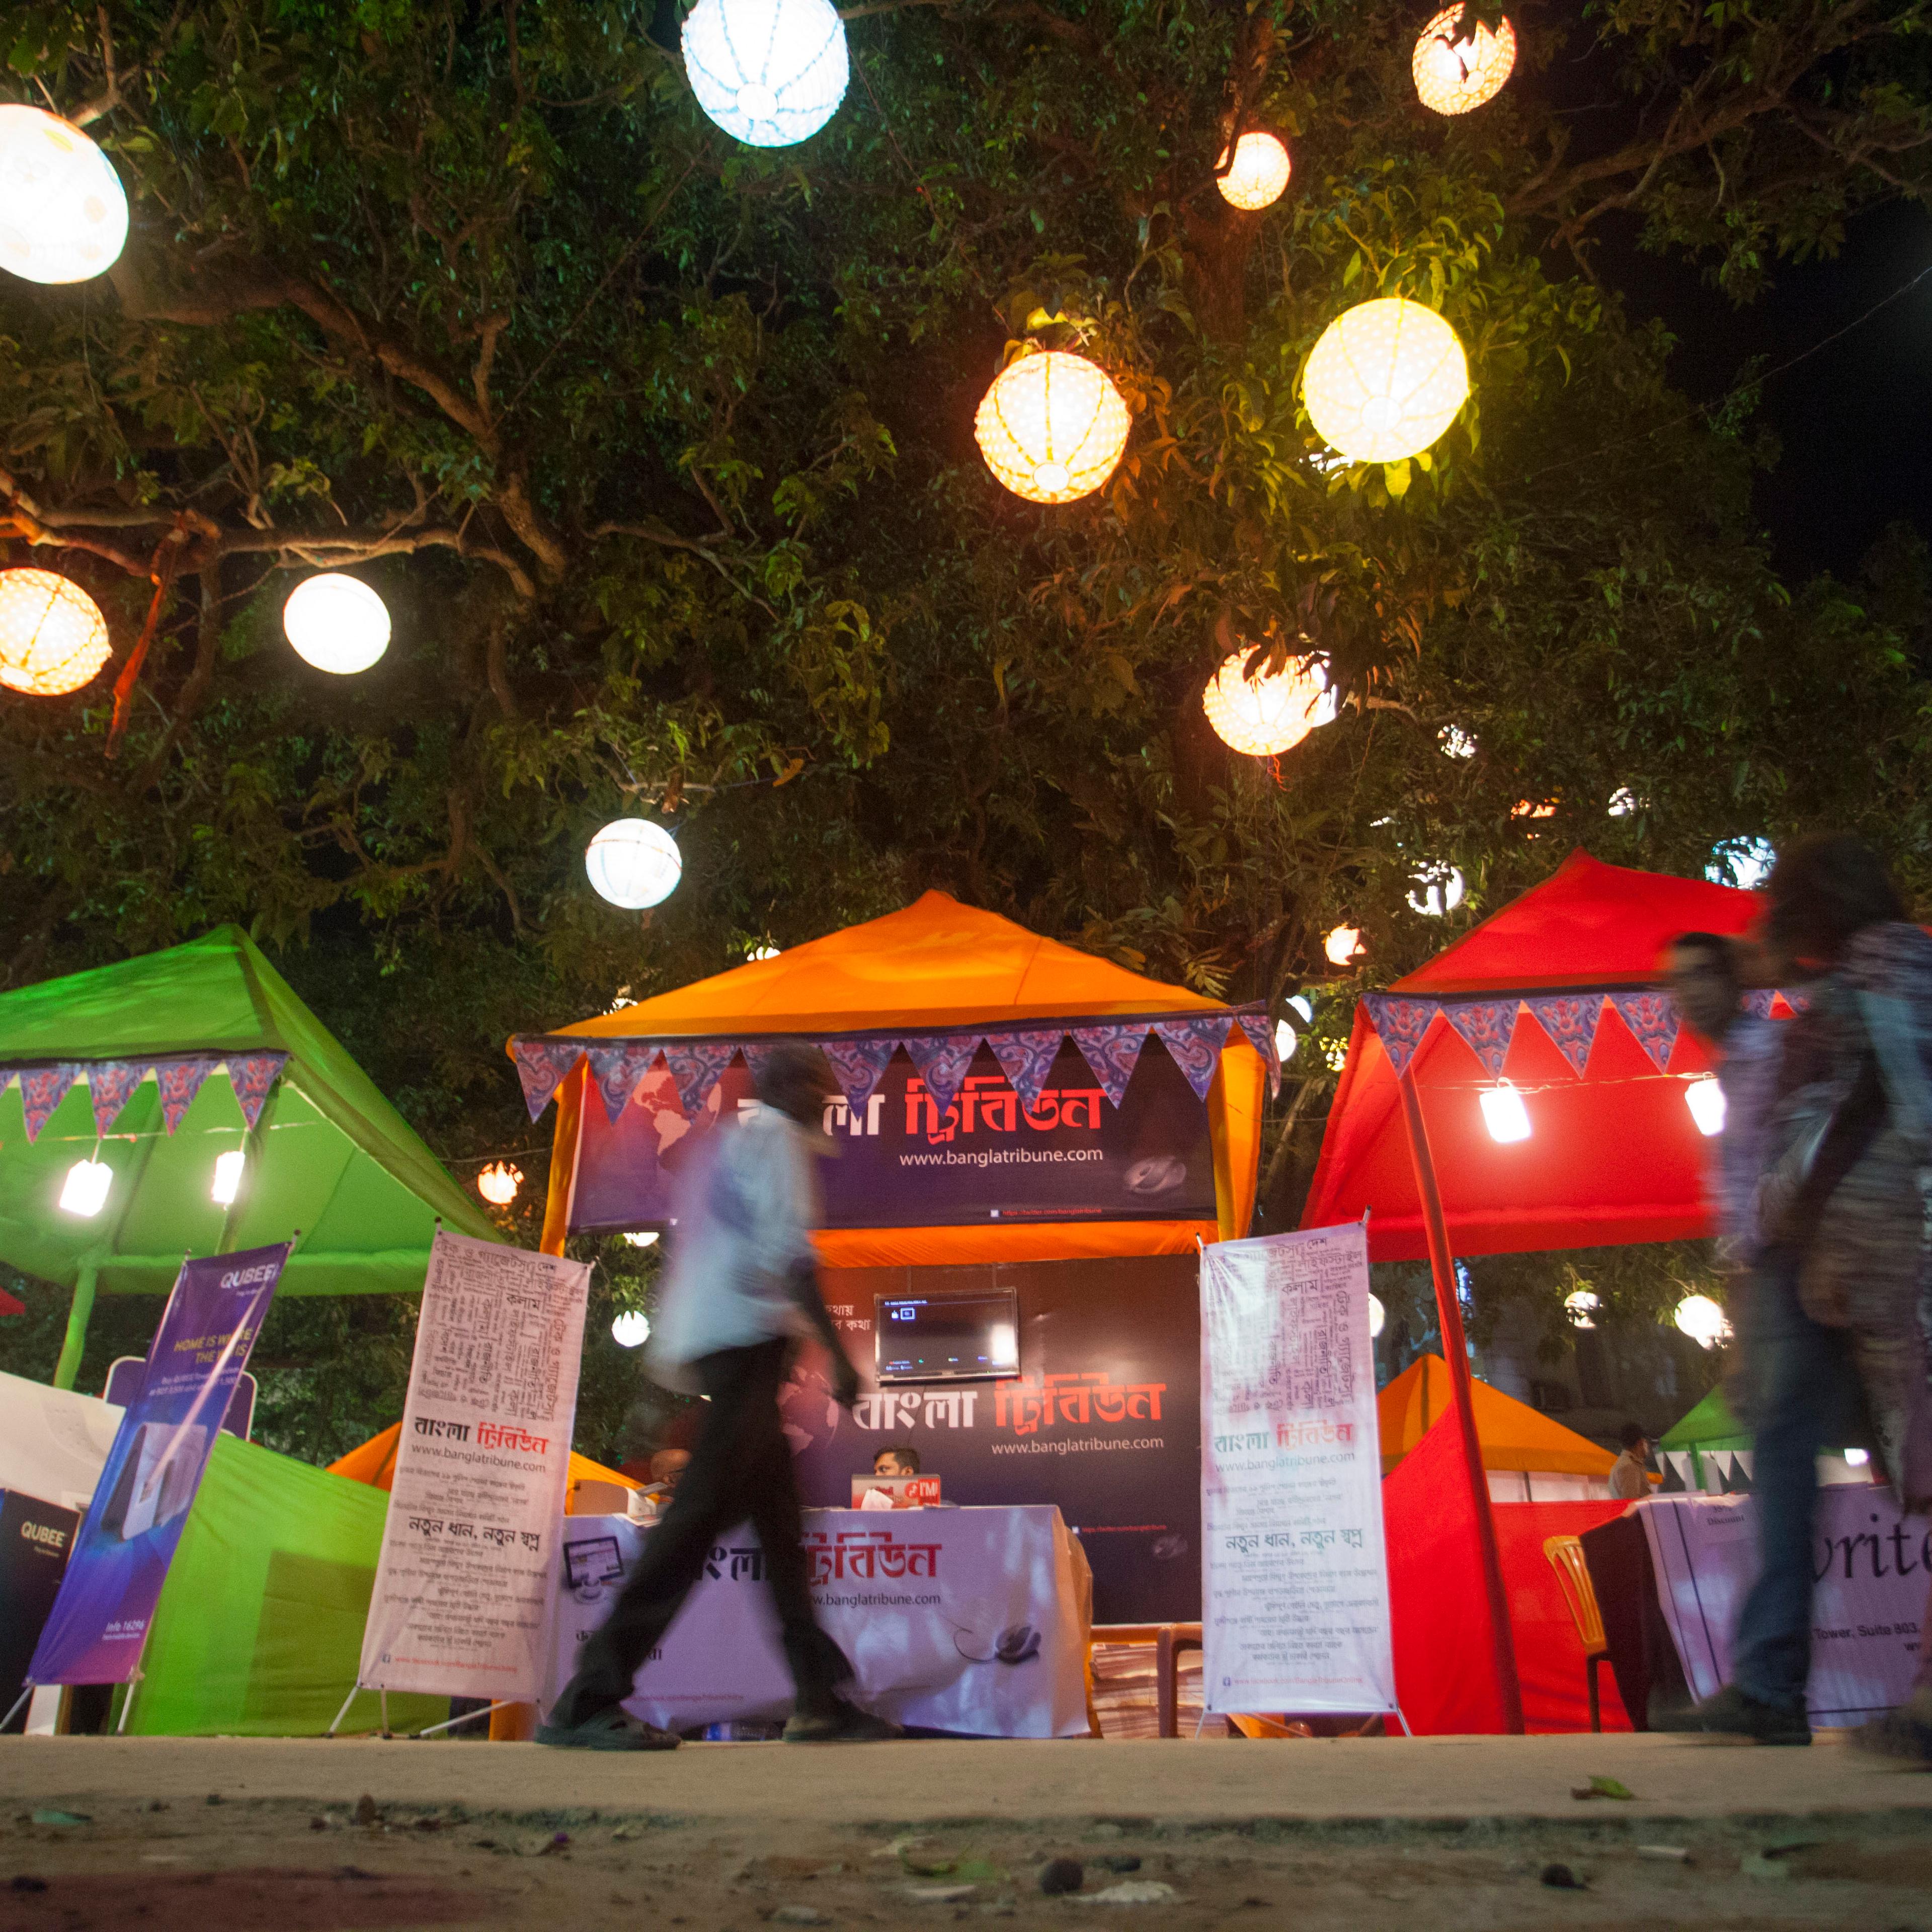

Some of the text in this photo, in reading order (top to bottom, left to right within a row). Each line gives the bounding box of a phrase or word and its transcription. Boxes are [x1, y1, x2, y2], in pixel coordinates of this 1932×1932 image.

[905, 1076, 1108, 1145] ট্রিবিউন
[900, 1148, 1103, 1167] www.banglatribune.com
[1281, 1279, 1318, 1295] কলাম
[845, 1319, 871, 1331] কথা
[853, 1373, 1166, 1436] বাংলা ট্রিবিউন
[414, 1416, 549, 1455] বাংলা ট্রিবিউন
[991, 1435, 1165, 1456] www.banglatribune.com
[1213, 1419, 1353, 1453] বাংলা ট্রিবিউন
[411, 1442, 546, 1473] www.banglatribune.com
[1215, 1453, 1355, 1473] www.banglatribune.com
[1707, 1514, 1744, 1526] Discount
[22, 1520, 65, 1548] QUBEE
[408, 1516, 444, 1537] নতুন
[447, 1520, 477, 1541] ধান,
[483, 1525, 516, 1547] নতুন
[520, 1531, 540, 1552] স্বপ্ন
[1225, 1527, 1363, 1554] নতুন ধান, নতুন স্বপ্ন
[813, 1593, 941, 1608] w.banglatribune.com
[1857, 1625, 1891, 1637] Suite
